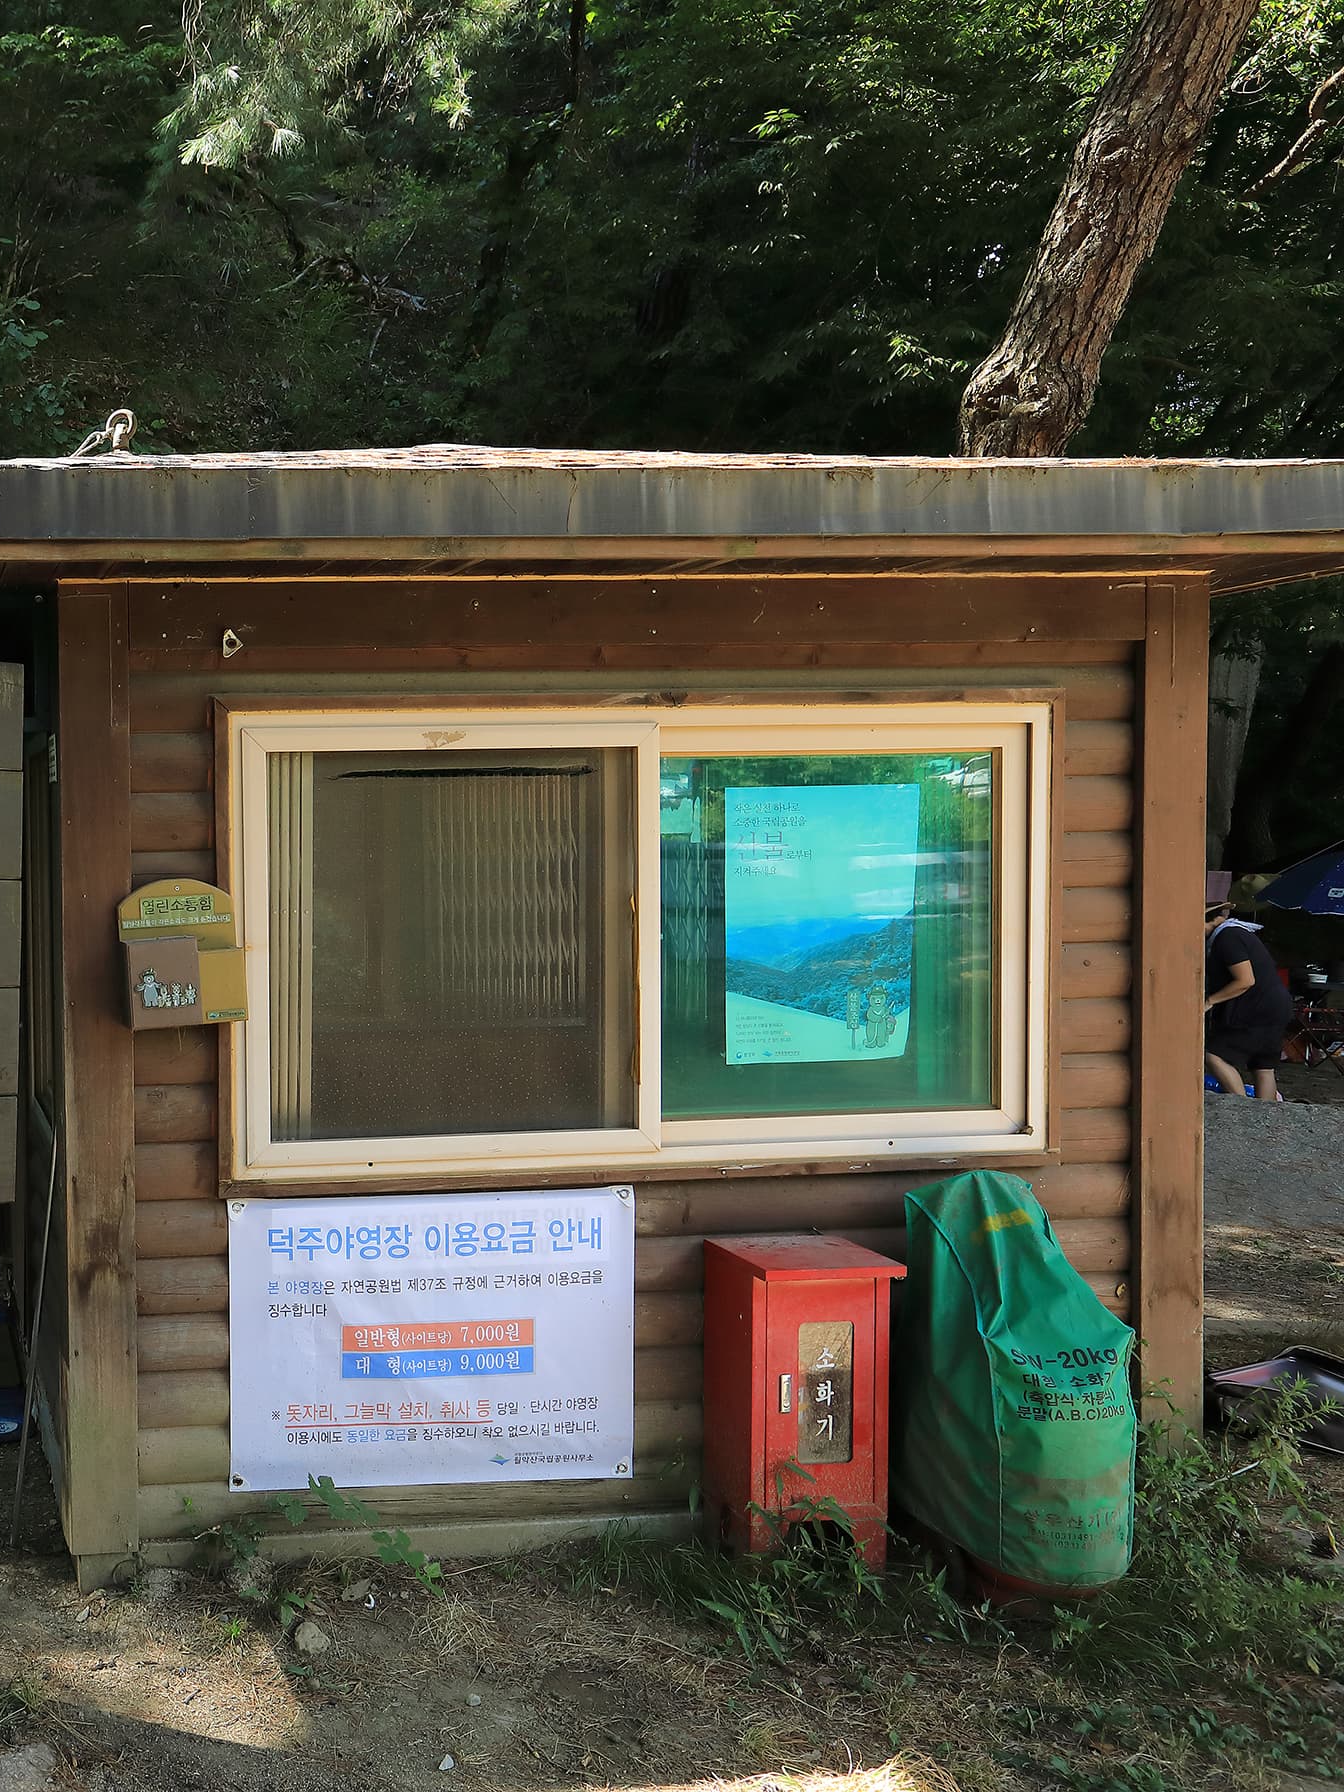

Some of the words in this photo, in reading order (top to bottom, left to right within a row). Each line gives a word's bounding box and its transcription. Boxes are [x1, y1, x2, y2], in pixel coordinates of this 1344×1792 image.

[267, 1224, 413, 1261] 덕주야영장
[424, 1221, 537, 1257] 이용요금
[548, 1216, 602, 1252] 안내
[267, 1281, 280, 1295] 본
[285, 1280, 336, 1295] 야영장은
[341, 1278, 401, 1294] 자연공원법
[407, 1277, 447, 1292] 제37조
[452, 1275, 488, 1291] 규정에
[493, 1273, 542, 1289] 근거하여
[547, 1269, 604, 1286] 이용요금을
[268, 1303, 328, 1318] 징수합니다
[460, 1323, 520, 1345] 7,000원
[460, 1350, 520, 1373] 9,000원
[815, 1346, 836, 1442] 소화기
[286, 1403, 338, 1423] 돗자리,
[344, 1402, 392, 1420] 그늘막
[398, 1401, 432, 1420] 설치,
[440, 1400, 470, 1419] 취사
[476, 1399, 492, 1418] 등
[497, 1401, 519, 1416] 당일
[530, 1399, 563, 1414] 단시간
[566, 1395, 599, 1410] 야영장
[287, 1430, 343, 1445] 이용시에도
[346, 1428, 380, 1443] 동일한
[383, 1427, 418, 1442] 요금을
[422, 1426, 478, 1441] 징수하오니
[482, 1425, 504, 1439] 착오
[507, 1422, 551, 1438] 없으시길
[554, 1419, 600, 1435] 바랍니다.
[514, 1453, 594, 1465] 월악산국립공원사무소
